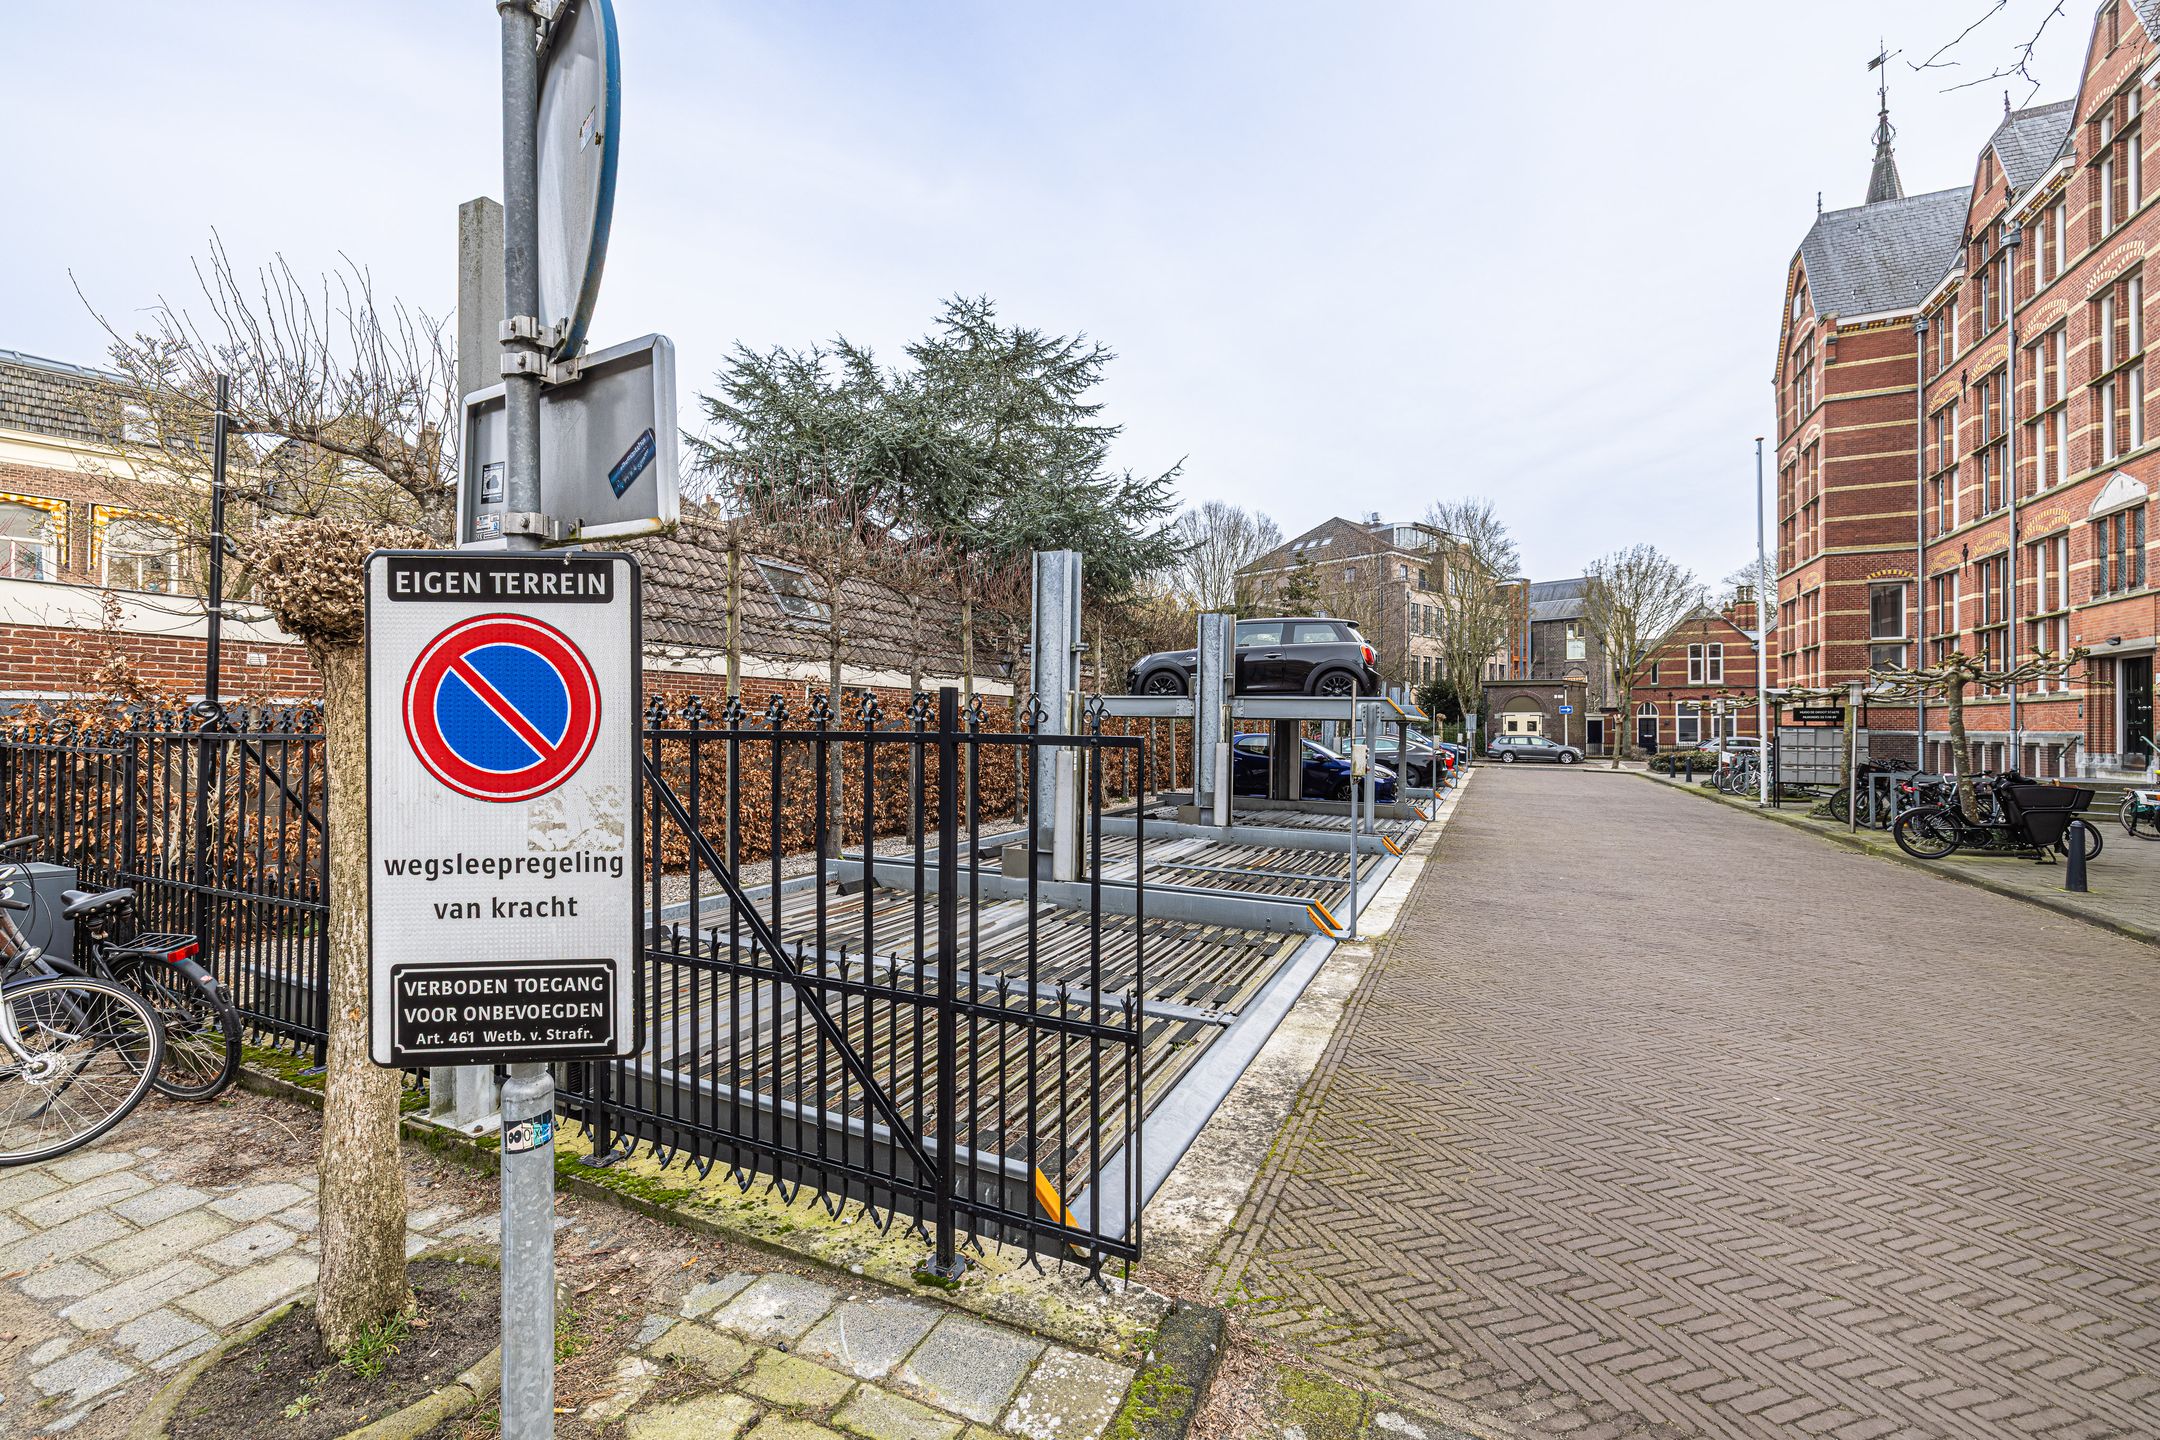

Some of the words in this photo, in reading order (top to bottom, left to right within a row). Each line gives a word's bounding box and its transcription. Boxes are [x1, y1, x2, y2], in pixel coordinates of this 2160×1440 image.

[396, 571, 480, 594] EIGEN
[490, 572, 605, 595] TERREIN
[384, 850, 624, 881] wegsleepregeling
[433, 902, 481, 919] van
[492, 896, 578, 918] kracht
[404, 979, 507, 996] VERBODEN
[514, 976, 604, 993] TOEGANG
[404, 1007, 457, 1023] VOOR
[464, 1003, 603, 1021] ONBEVOEGDEN
[416, 1033, 444, 1045] Art.
[448, 1031, 475, 1043] 461
[483, 1030, 526, 1042] Wetb.
[530, 1031, 542, 1041] v.
[546, 1028, 593, 1041] Strafr.
